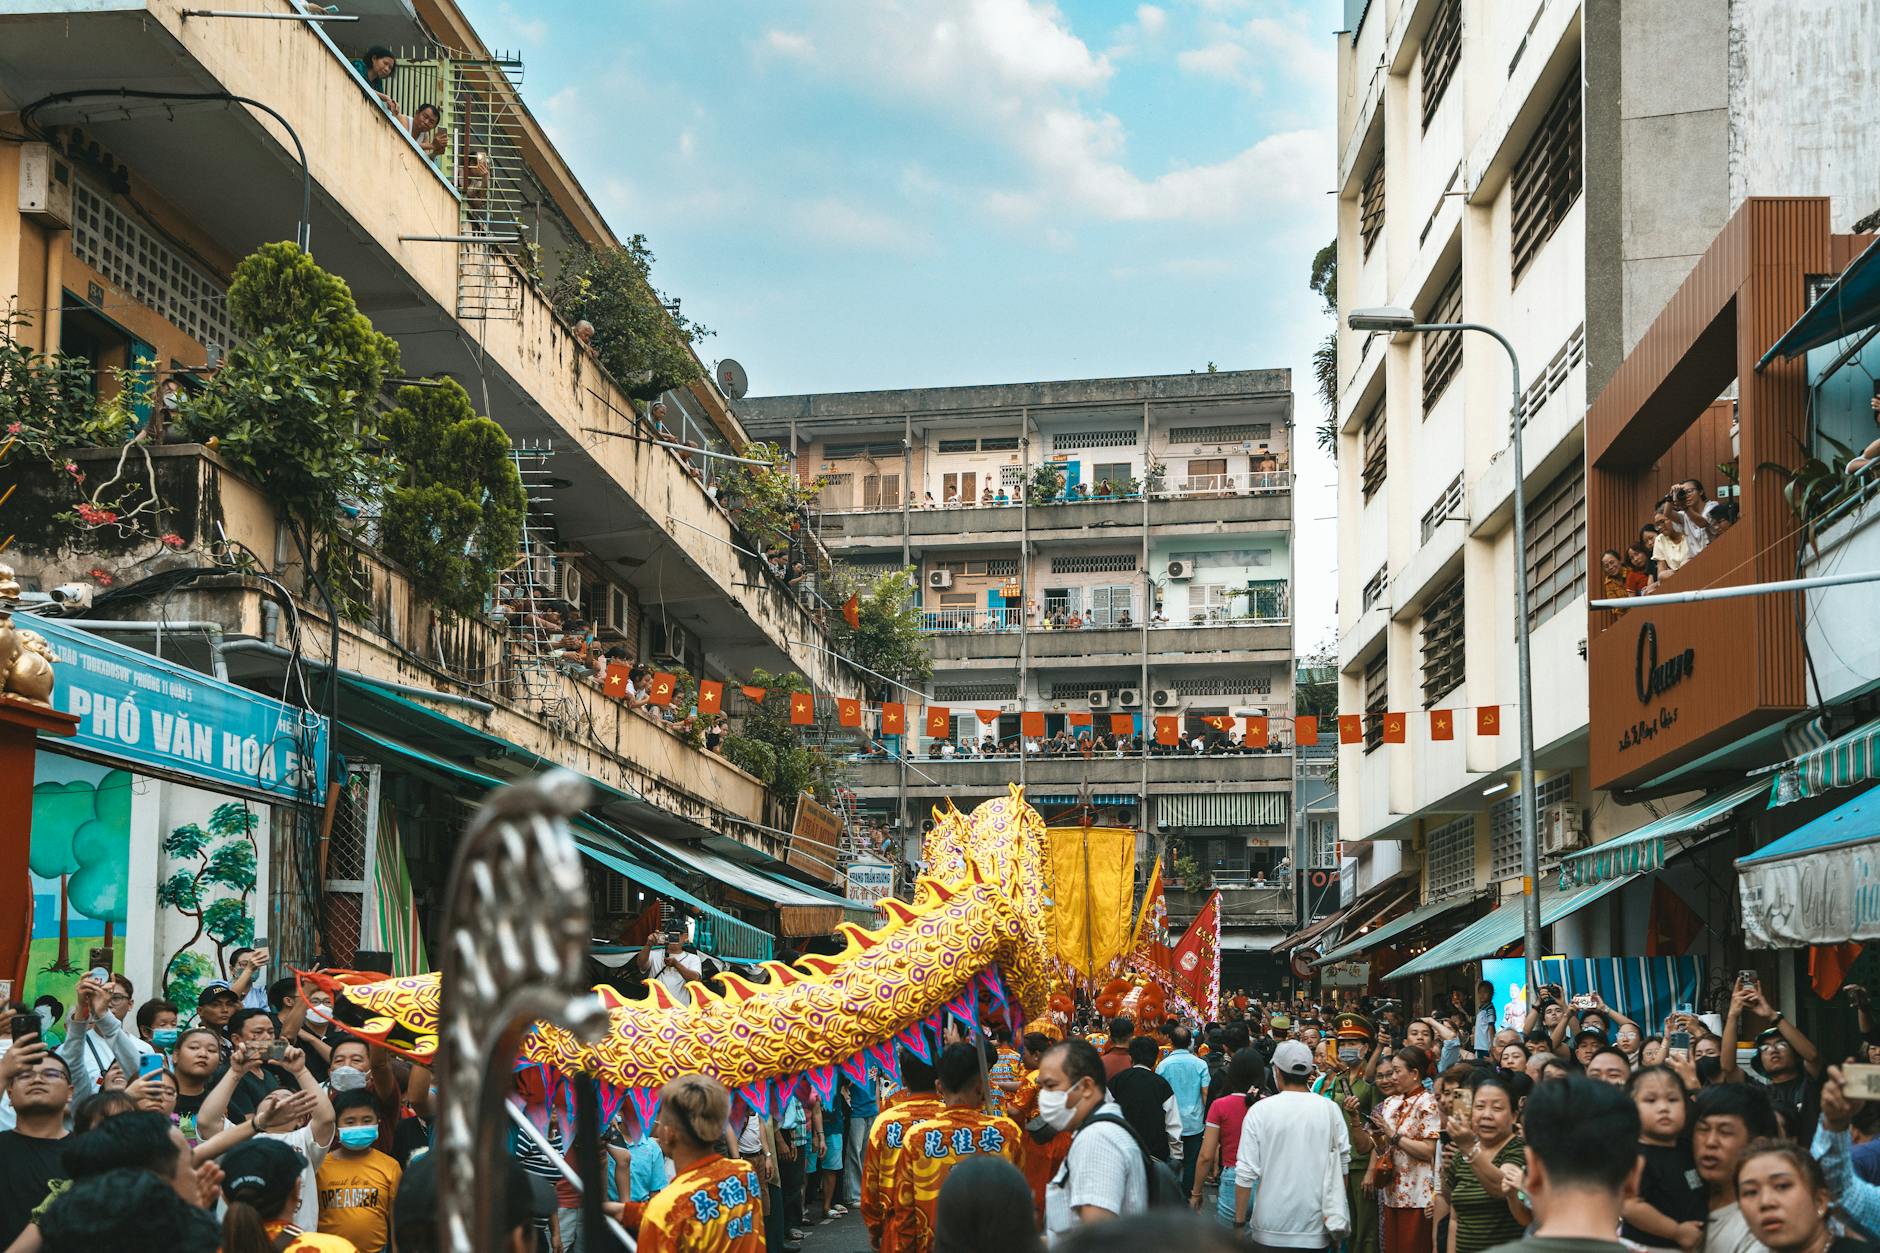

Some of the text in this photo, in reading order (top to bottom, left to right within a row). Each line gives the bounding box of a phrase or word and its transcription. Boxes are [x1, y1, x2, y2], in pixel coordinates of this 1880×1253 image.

[69, 686, 141, 745] PHỐ
[151, 709, 213, 765] VĂN
[222, 732, 277, 782] HÓA
[321, 1187, 379, 1209] DREAMER
